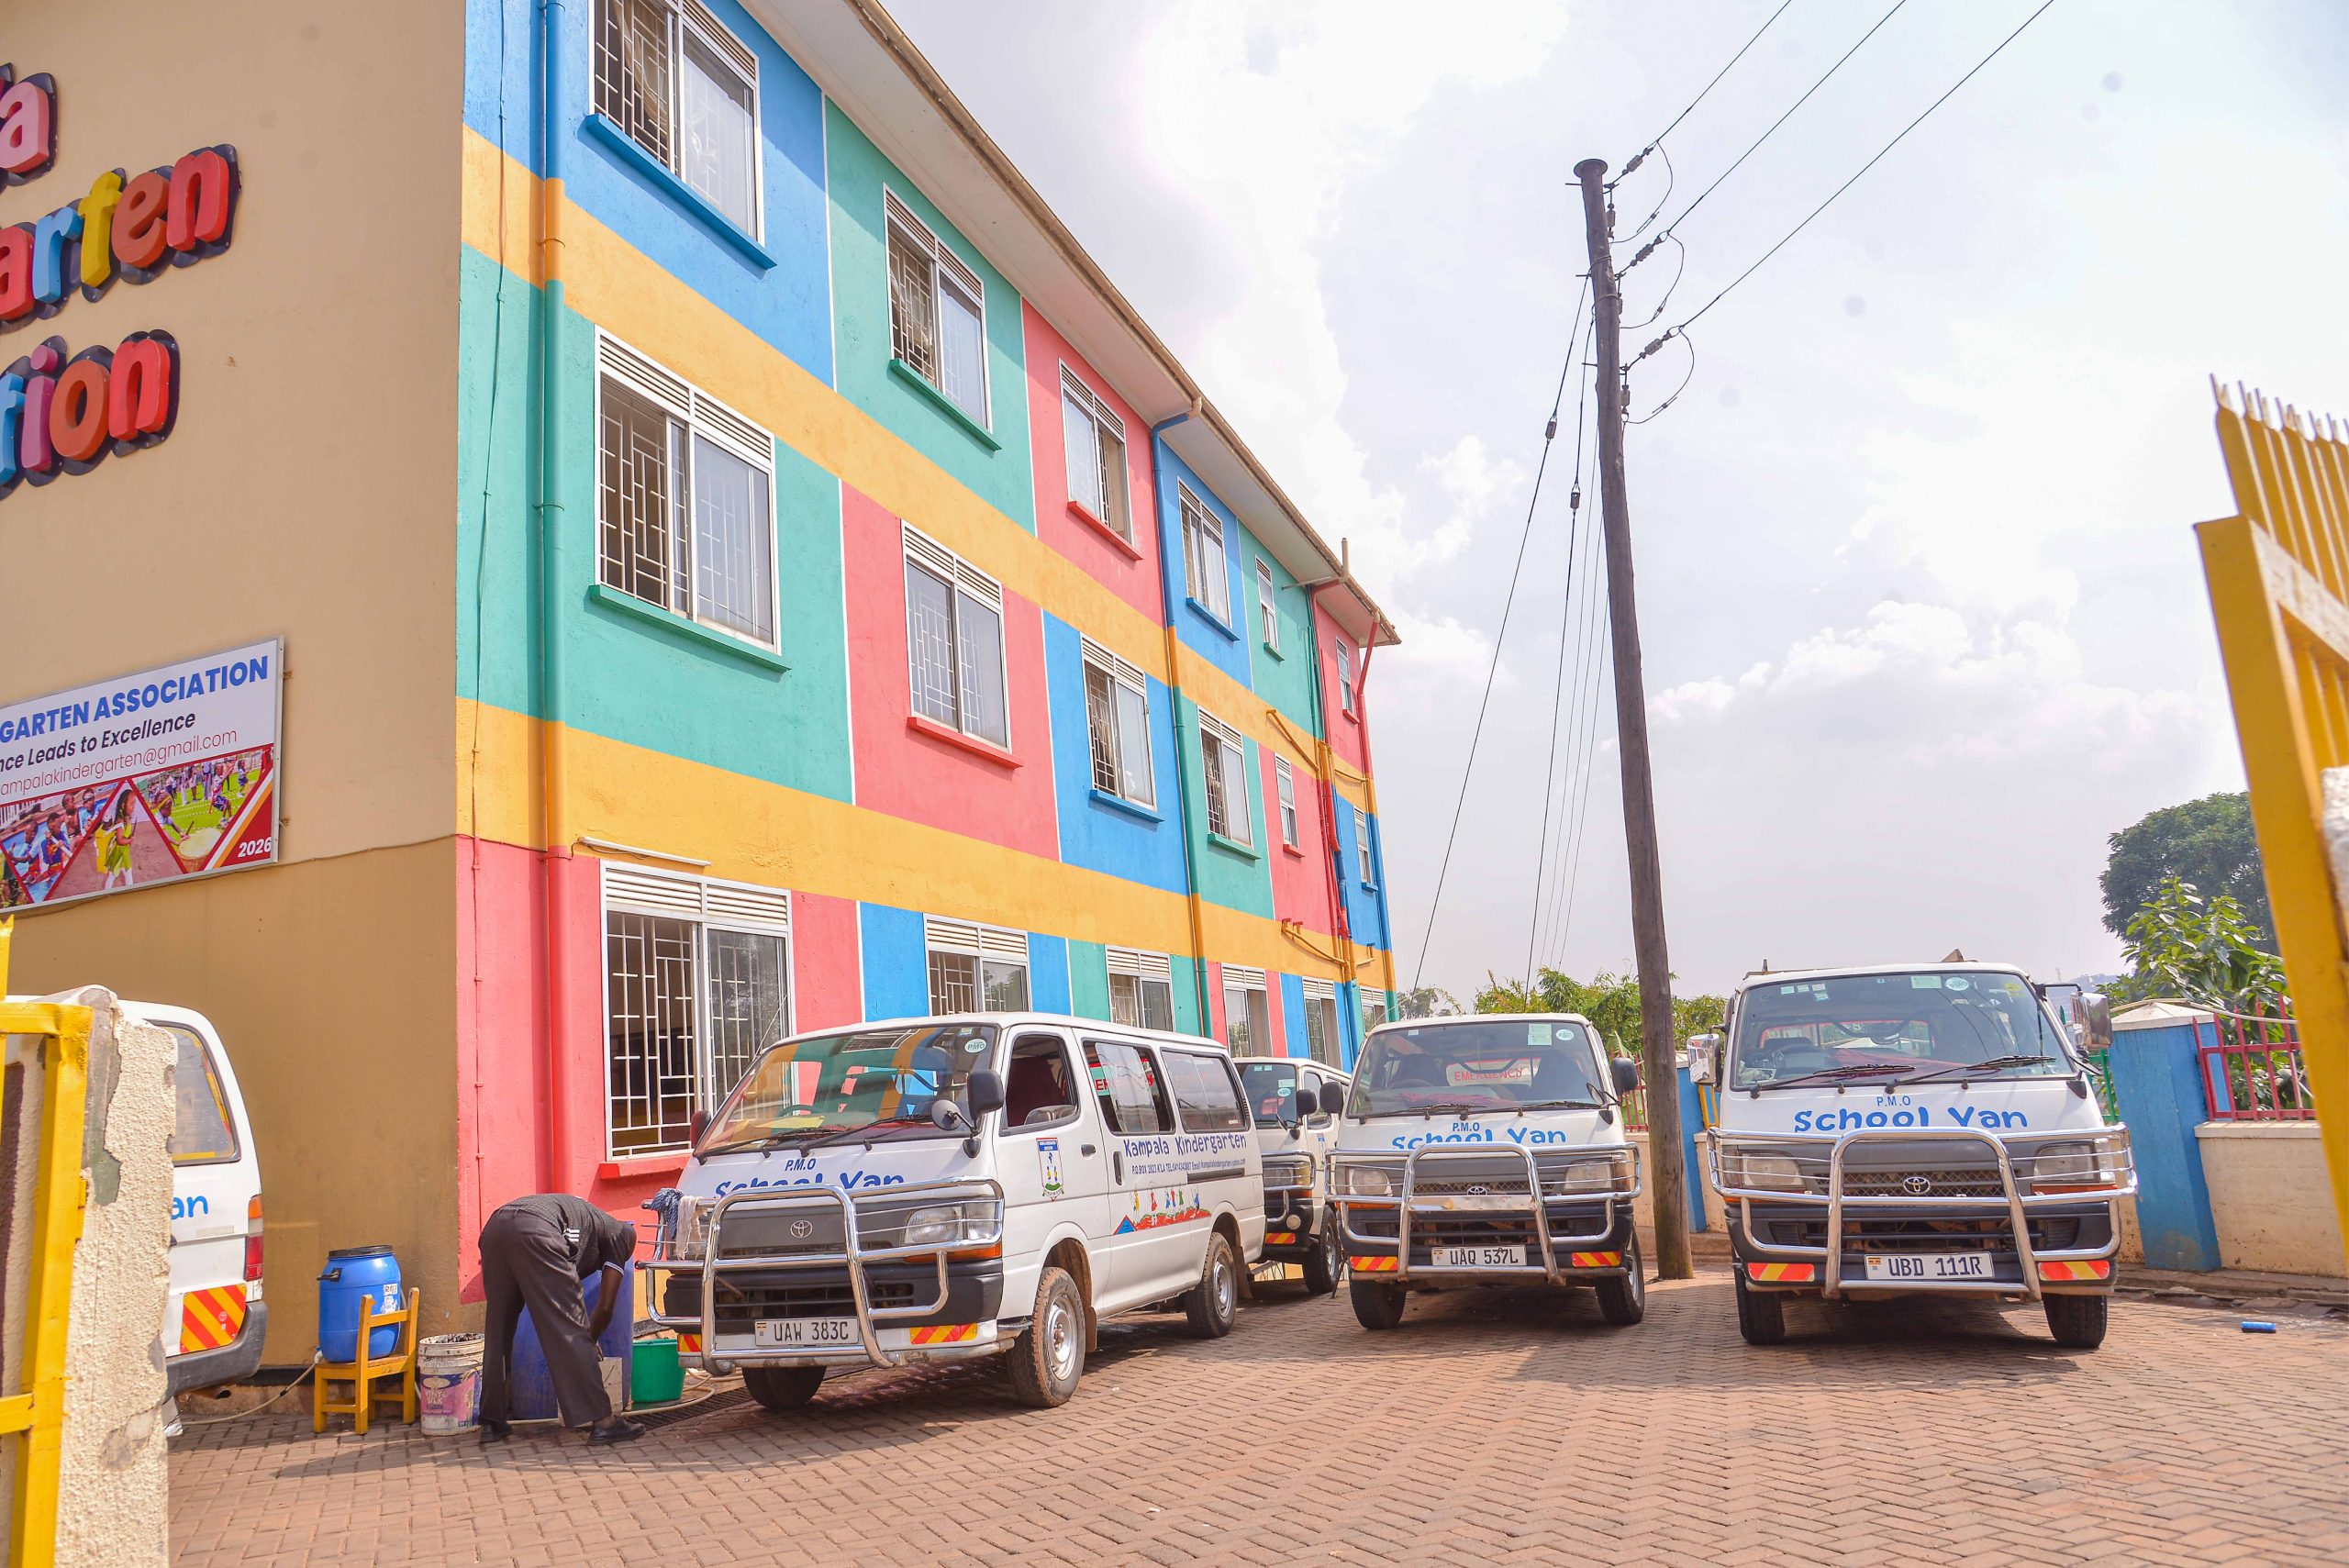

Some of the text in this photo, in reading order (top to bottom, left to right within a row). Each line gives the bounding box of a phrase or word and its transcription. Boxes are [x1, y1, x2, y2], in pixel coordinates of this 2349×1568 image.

[0, 150, 229, 320] arten
[0, 655, 268, 743] GARTEN ASSOCIATION
[28, 738, 76, 764] Leads
[80, 735, 98, 752] to
[101, 711, 196, 749] Excellence
[238, 835, 272, 858] 2026
[1876, 1095, 1911, 1107] P.M.O
[1452, 1121, 1480, 1132] P.M.O
[1794, 1106, 2028, 1133] School Van
[1123, 1133, 1247, 1158] Kampala Kindergarten
[1507, 1127, 1566, 1144] Van
[785, 1158, 817, 1172] P.M.O
[1450, 1248, 1519, 1265] UAQ 537L
[1887, 1256, 1983, 1277] UBD 111R
[774, 1321, 849, 1341] UAW 383C
